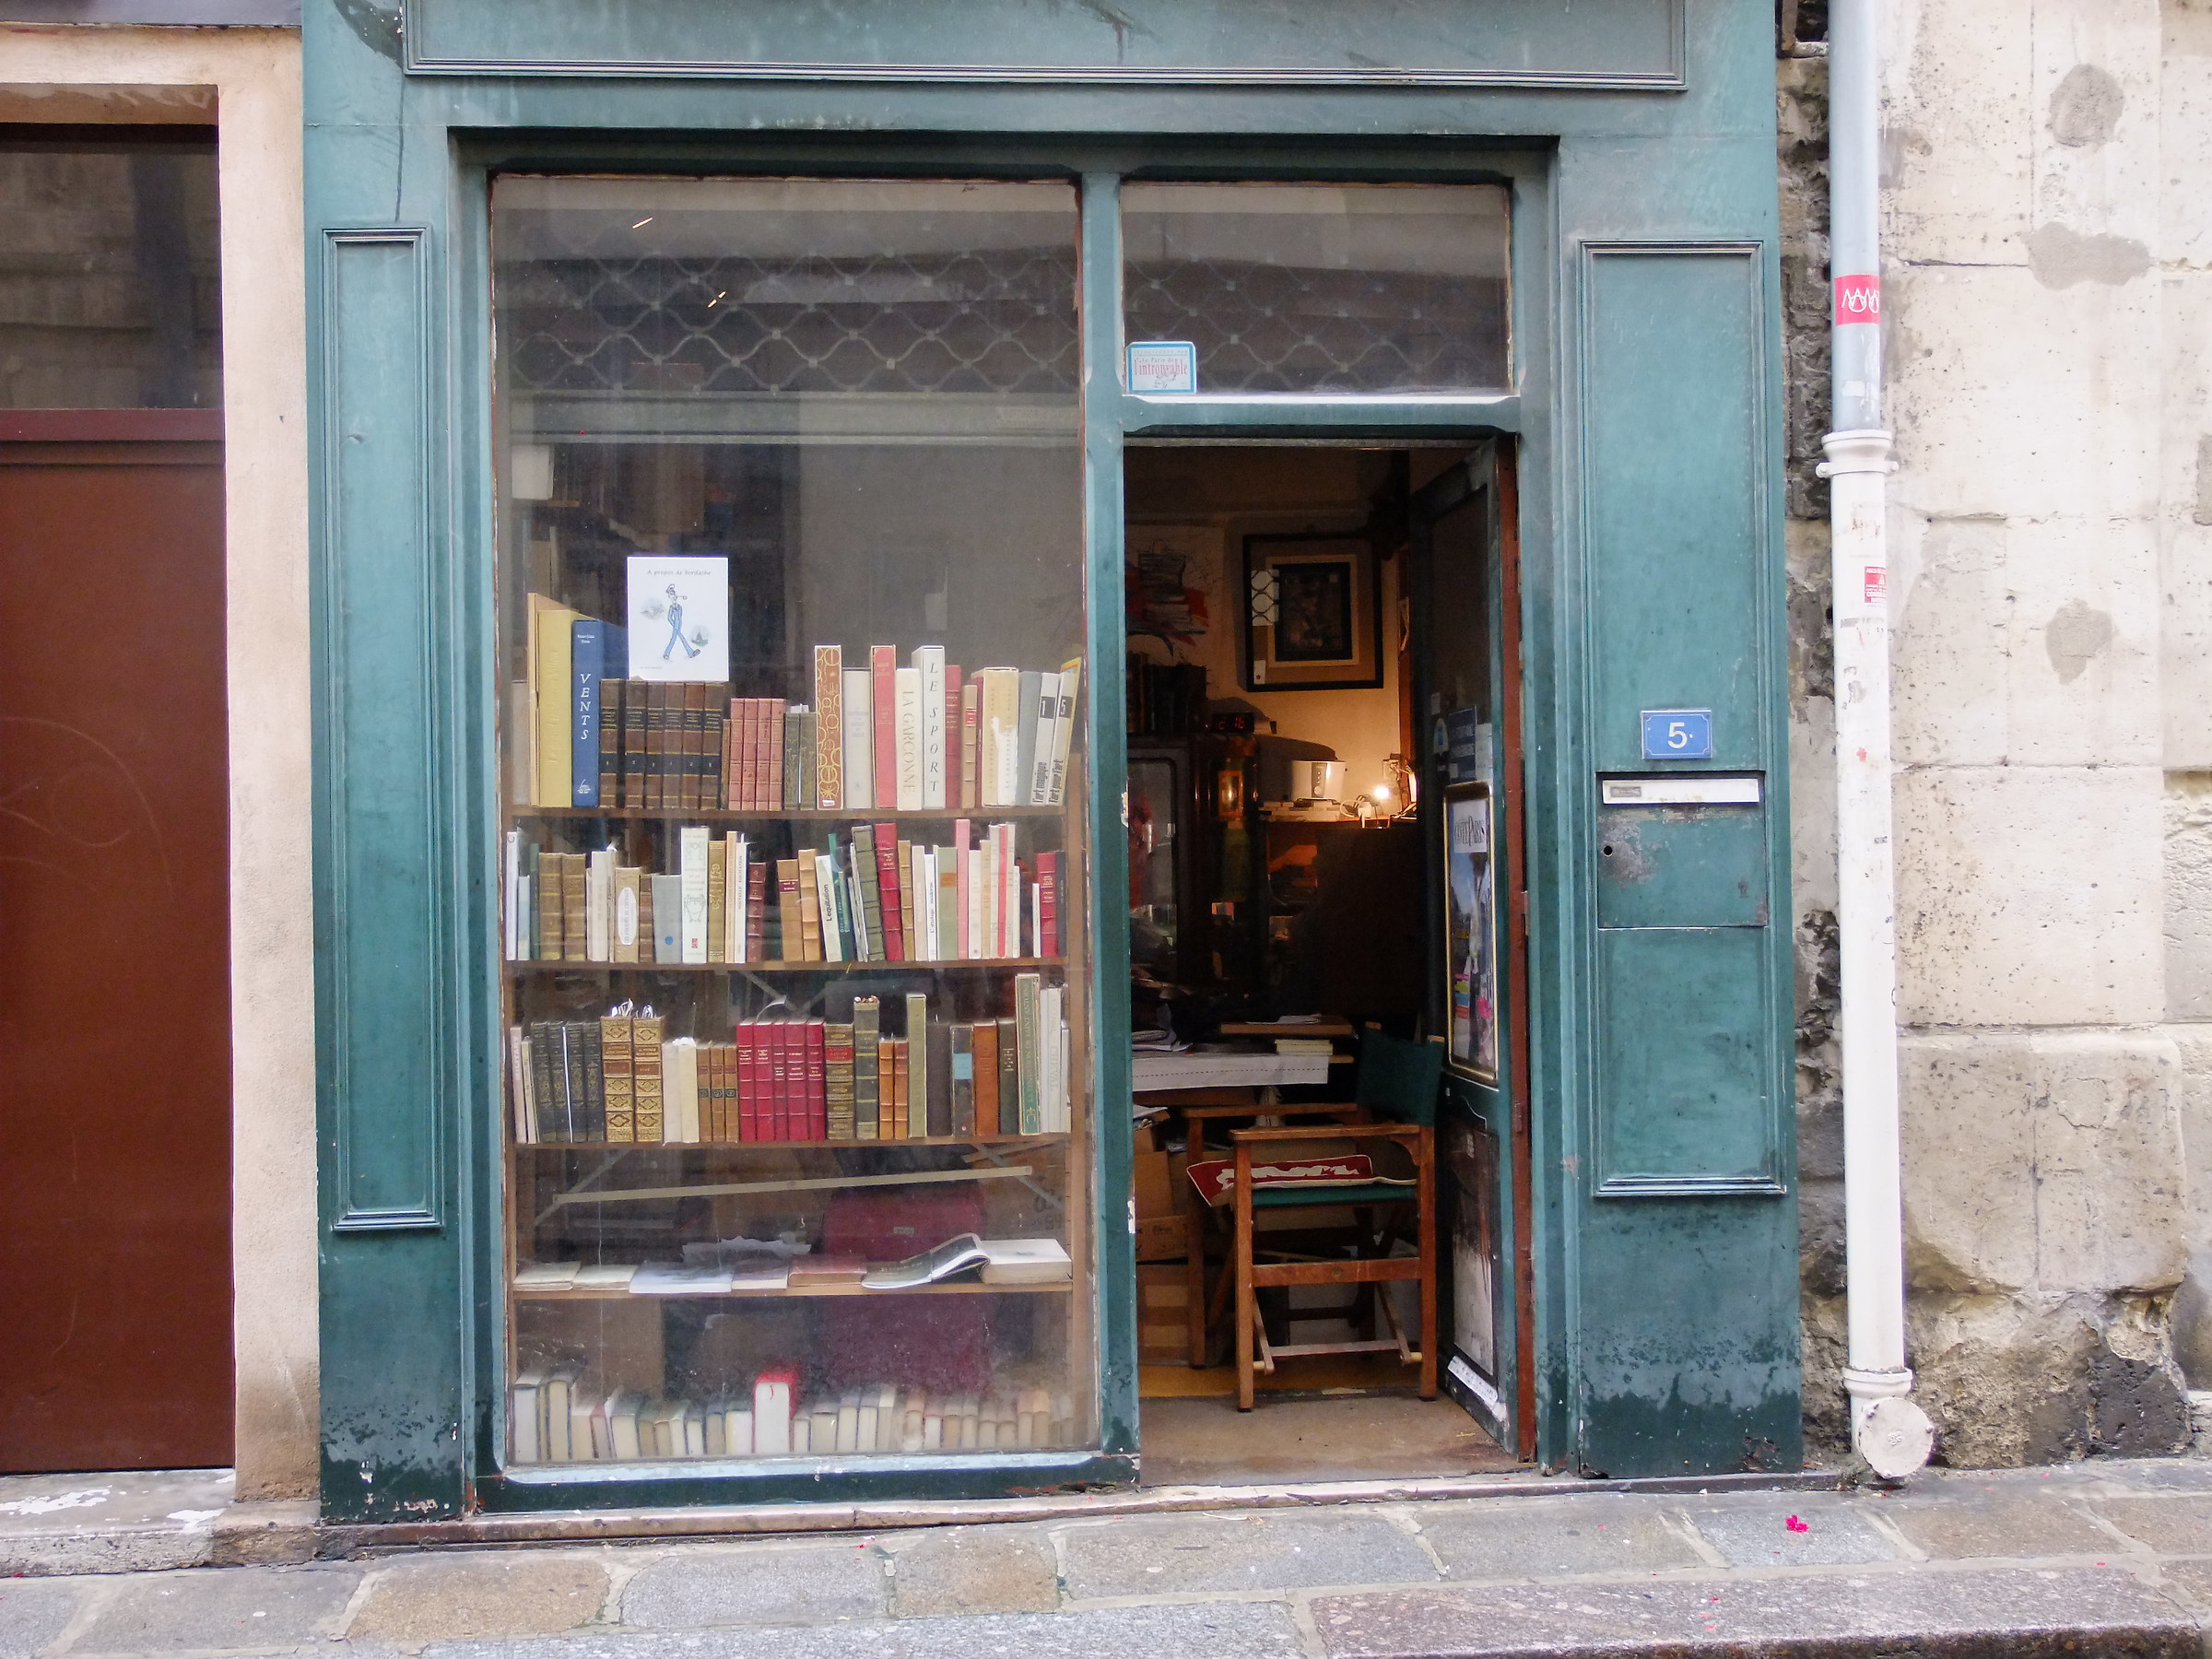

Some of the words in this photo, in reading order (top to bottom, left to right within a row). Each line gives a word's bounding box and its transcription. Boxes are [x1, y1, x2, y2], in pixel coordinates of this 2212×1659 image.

[579, 673, 592, 740] VENTS
[901, 690, 914, 707] LA
[1040, 700, 1047, 716] 1
[1060, 699, 1066, 715] 5
[1666, 722, 1688, 749] 5
[929, 706, 938, 793] SPORT
